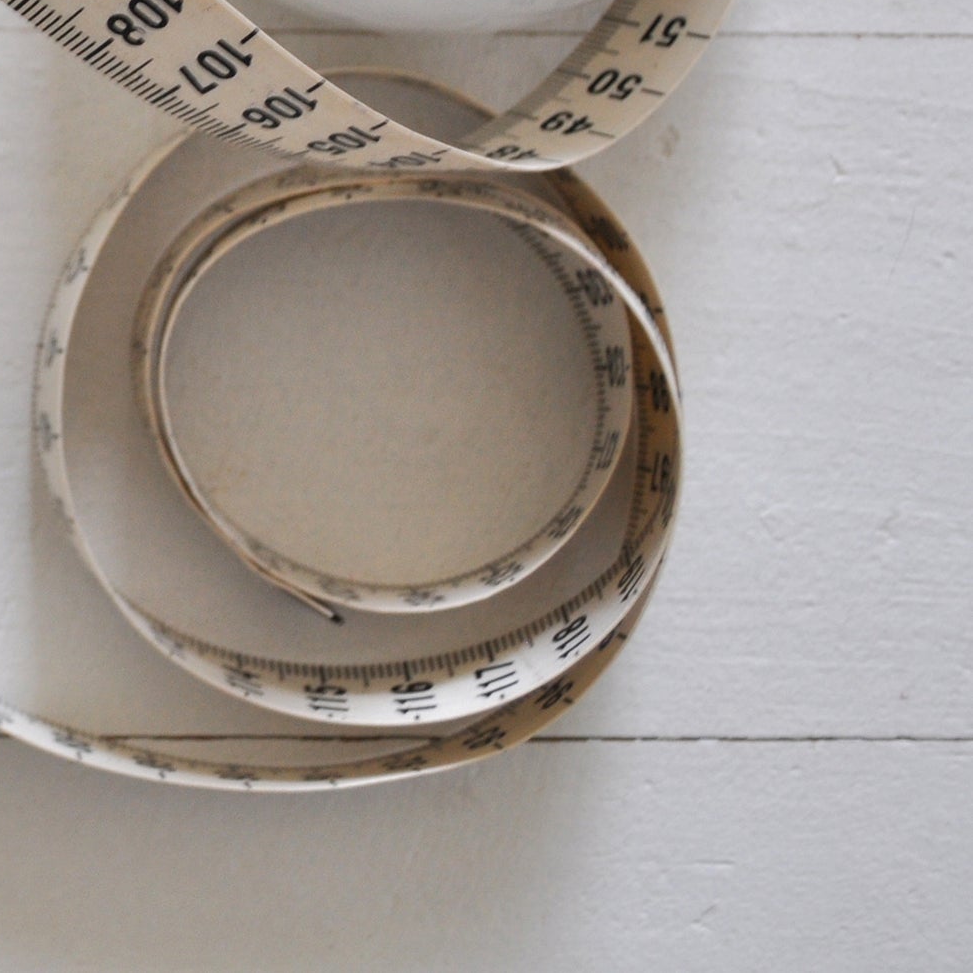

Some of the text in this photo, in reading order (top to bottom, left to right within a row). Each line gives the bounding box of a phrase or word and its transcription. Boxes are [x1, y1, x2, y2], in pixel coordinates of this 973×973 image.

[640, 14, 688, 47] 51
[179, 38, 253, 94] 107
[587, 68, 642, 100] 50
[242, 87, 318, 128] 106
[539, 111, 594, 135] 49
[308, 126, 381, 155] 105
[552, 614, 591, 660] 118
[475, 661, 519, 698] 117
[391, 681, 437, 714] 116
